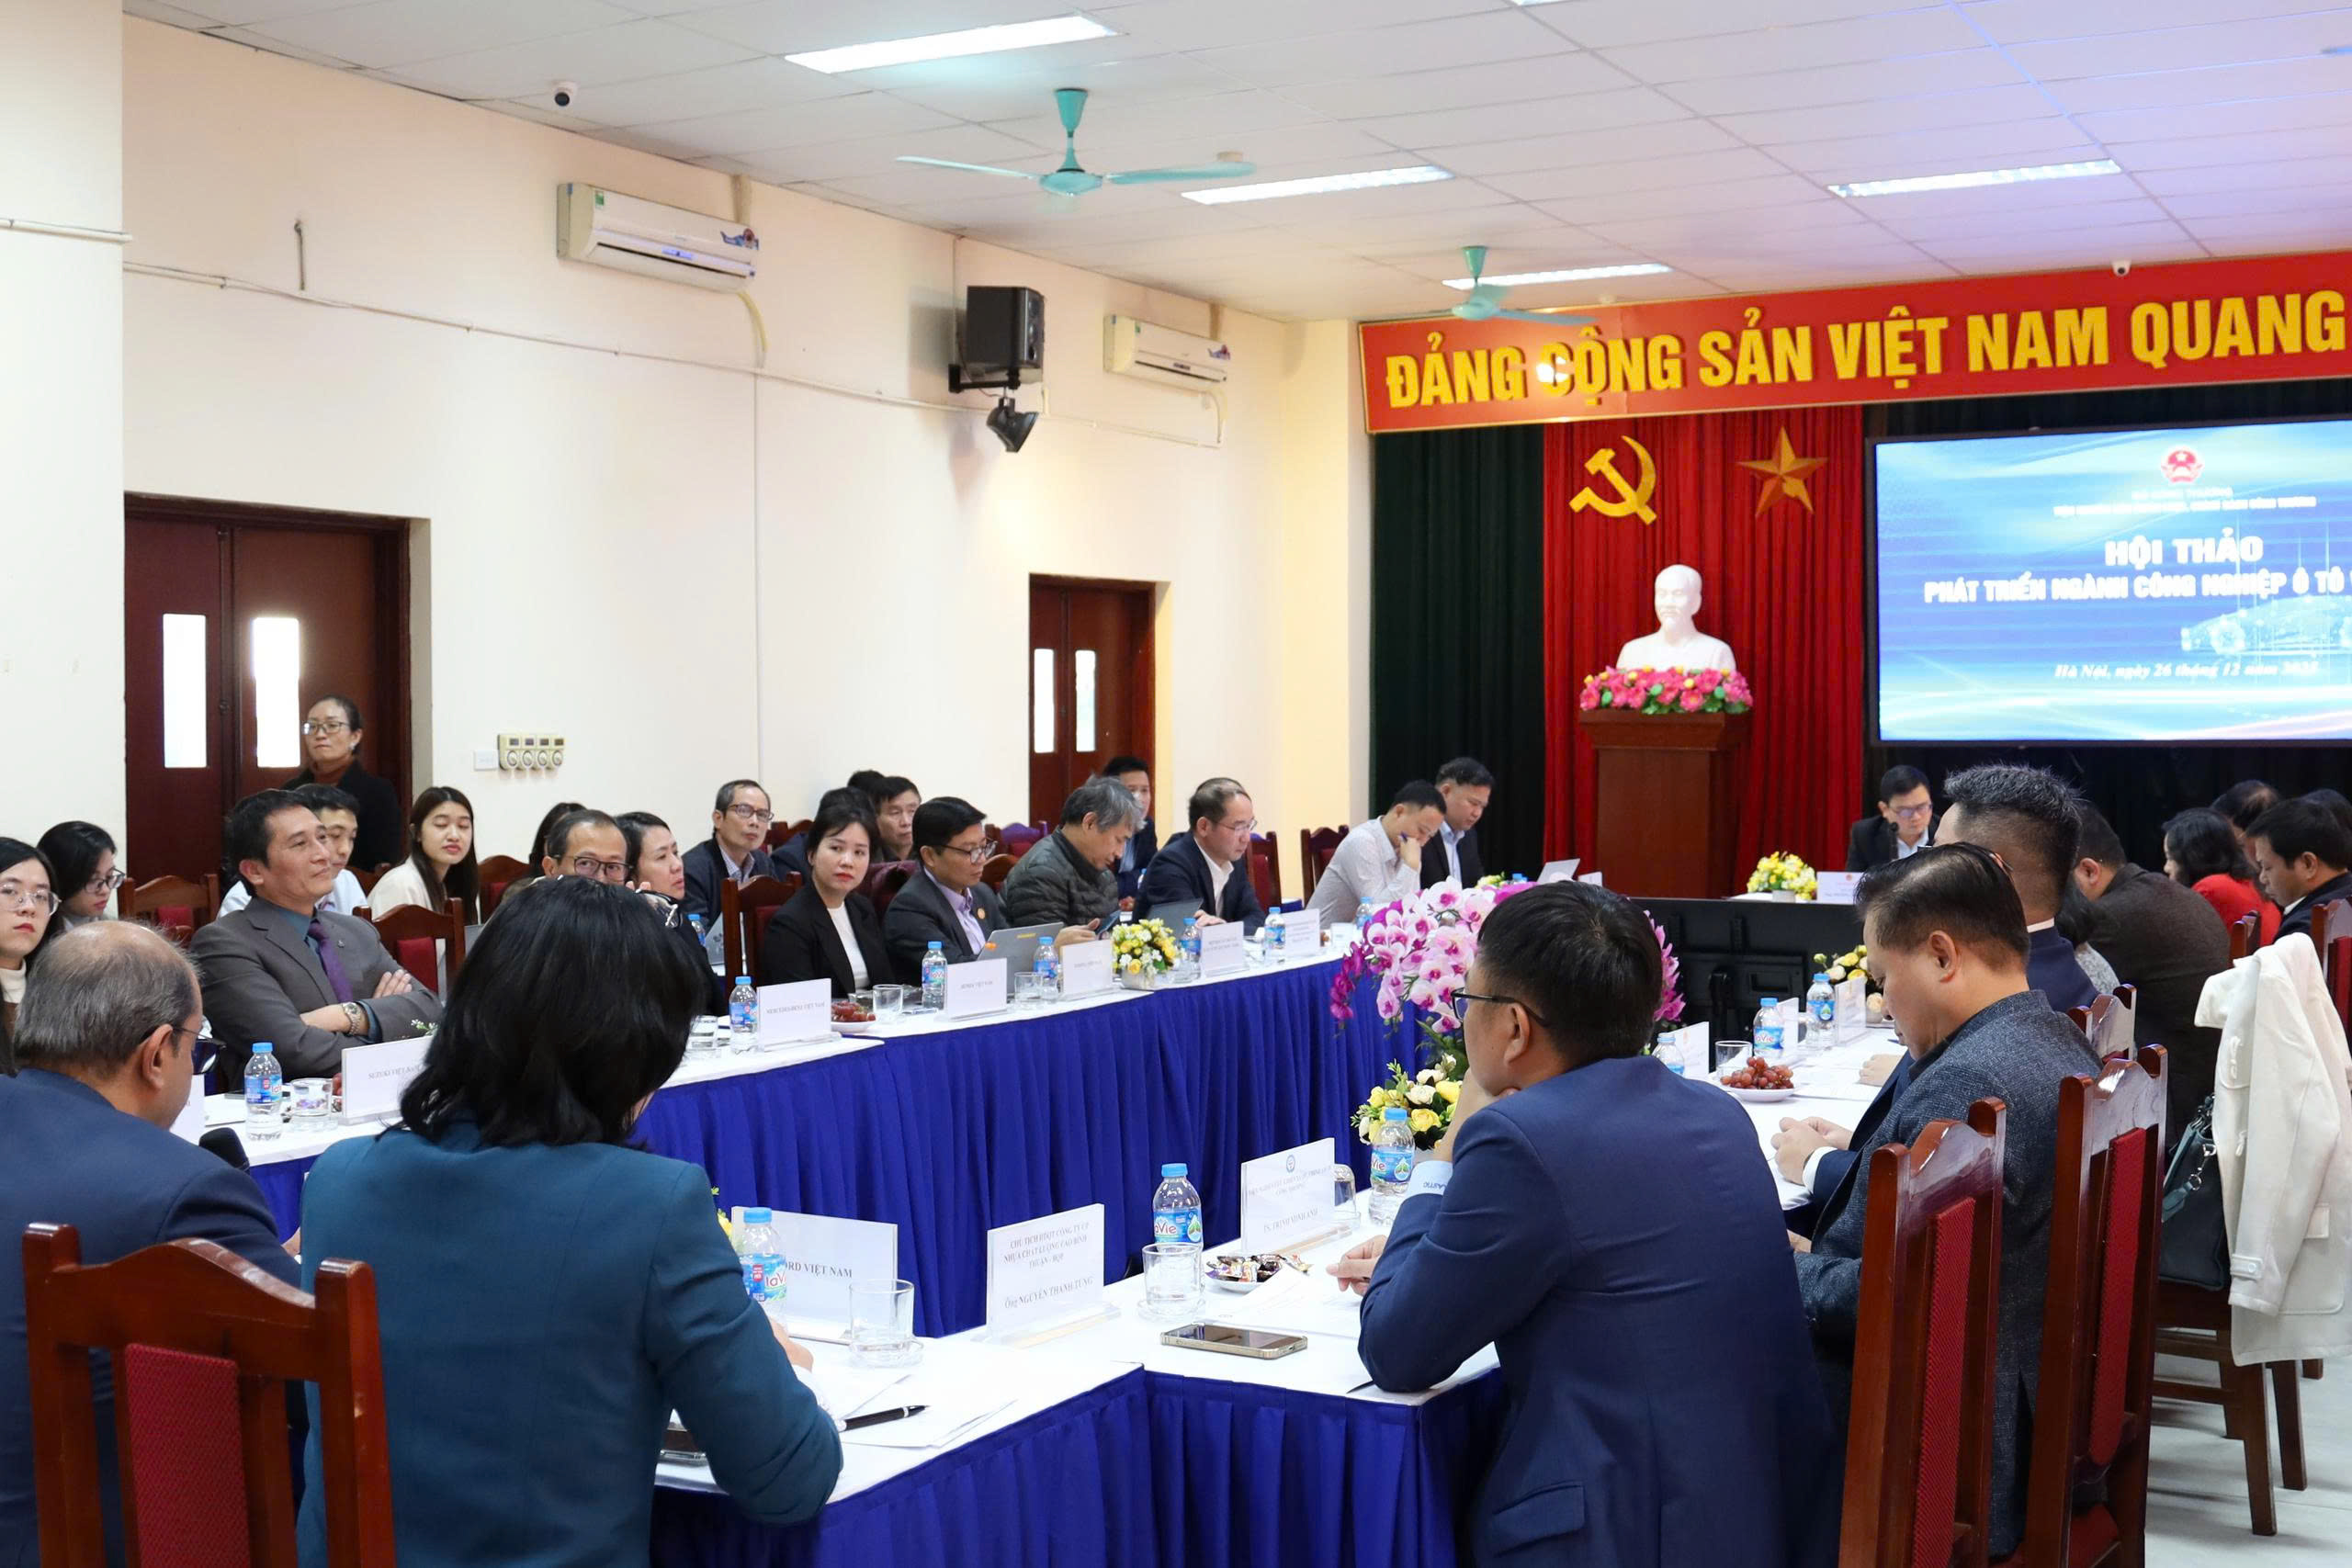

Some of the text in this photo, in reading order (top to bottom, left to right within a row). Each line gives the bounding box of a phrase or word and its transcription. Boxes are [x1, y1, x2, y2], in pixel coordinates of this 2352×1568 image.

[1385, 290, 2346, 408] ĐẢNG CỘNG SẢN VIỆT NAM QUANG
[2105, 527, 2264, 570] HỘI THẢO
[1924, 577, 1979, 603] PHÁT
[2051, 573, 2129, 600] NGÀNH
[2133, 571, 2196, 598] CÔNG
[2292, 567, 2310, 594] Ô
[2314, 566, 2345, 593] TÔ
[803, 1263, 827, 1277] VIỆT
[831, 1266, 853, 1279] NAM
